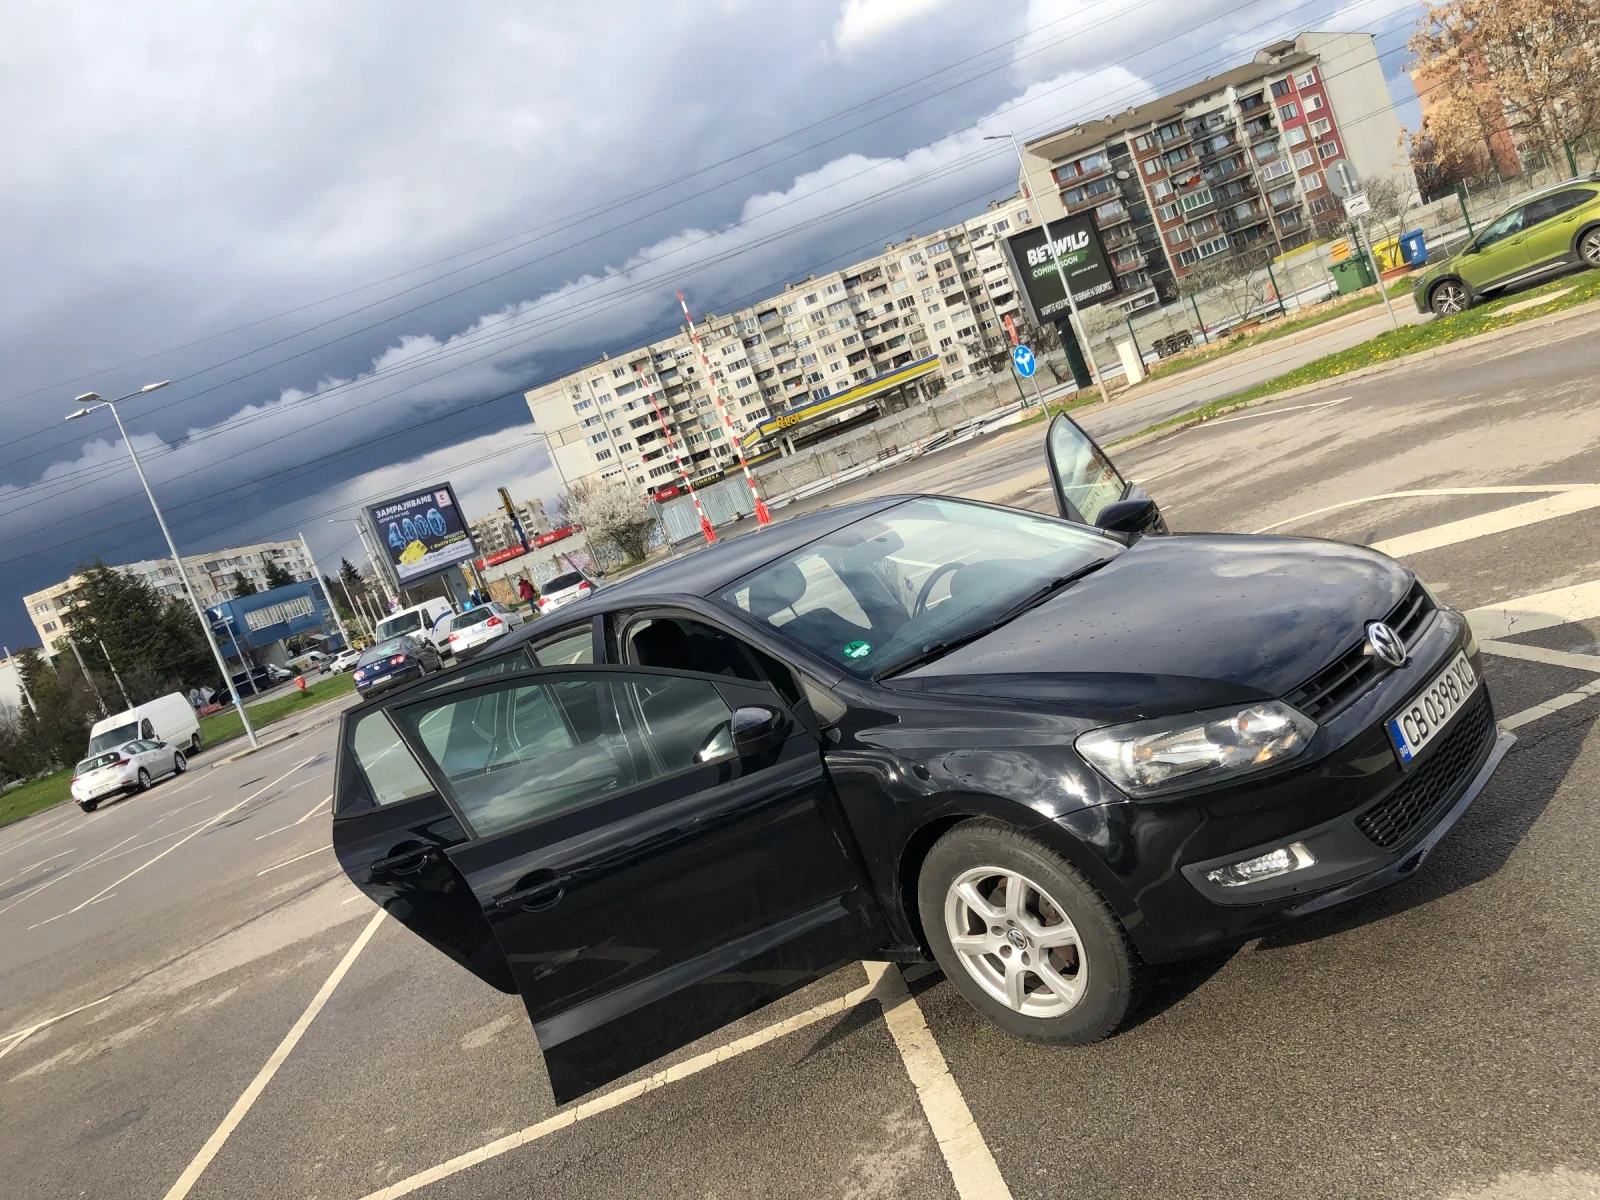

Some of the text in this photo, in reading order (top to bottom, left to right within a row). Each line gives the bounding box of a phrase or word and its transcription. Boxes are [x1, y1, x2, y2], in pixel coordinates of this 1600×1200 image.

[376, 494, 432, 518] ЗАМРАЗЯВАМЕ
[388, 508, 447, 550] 4000
[1402, 657, 1474, 747] CB 0398 XC
[1399, 744, 1409, 757] BG
